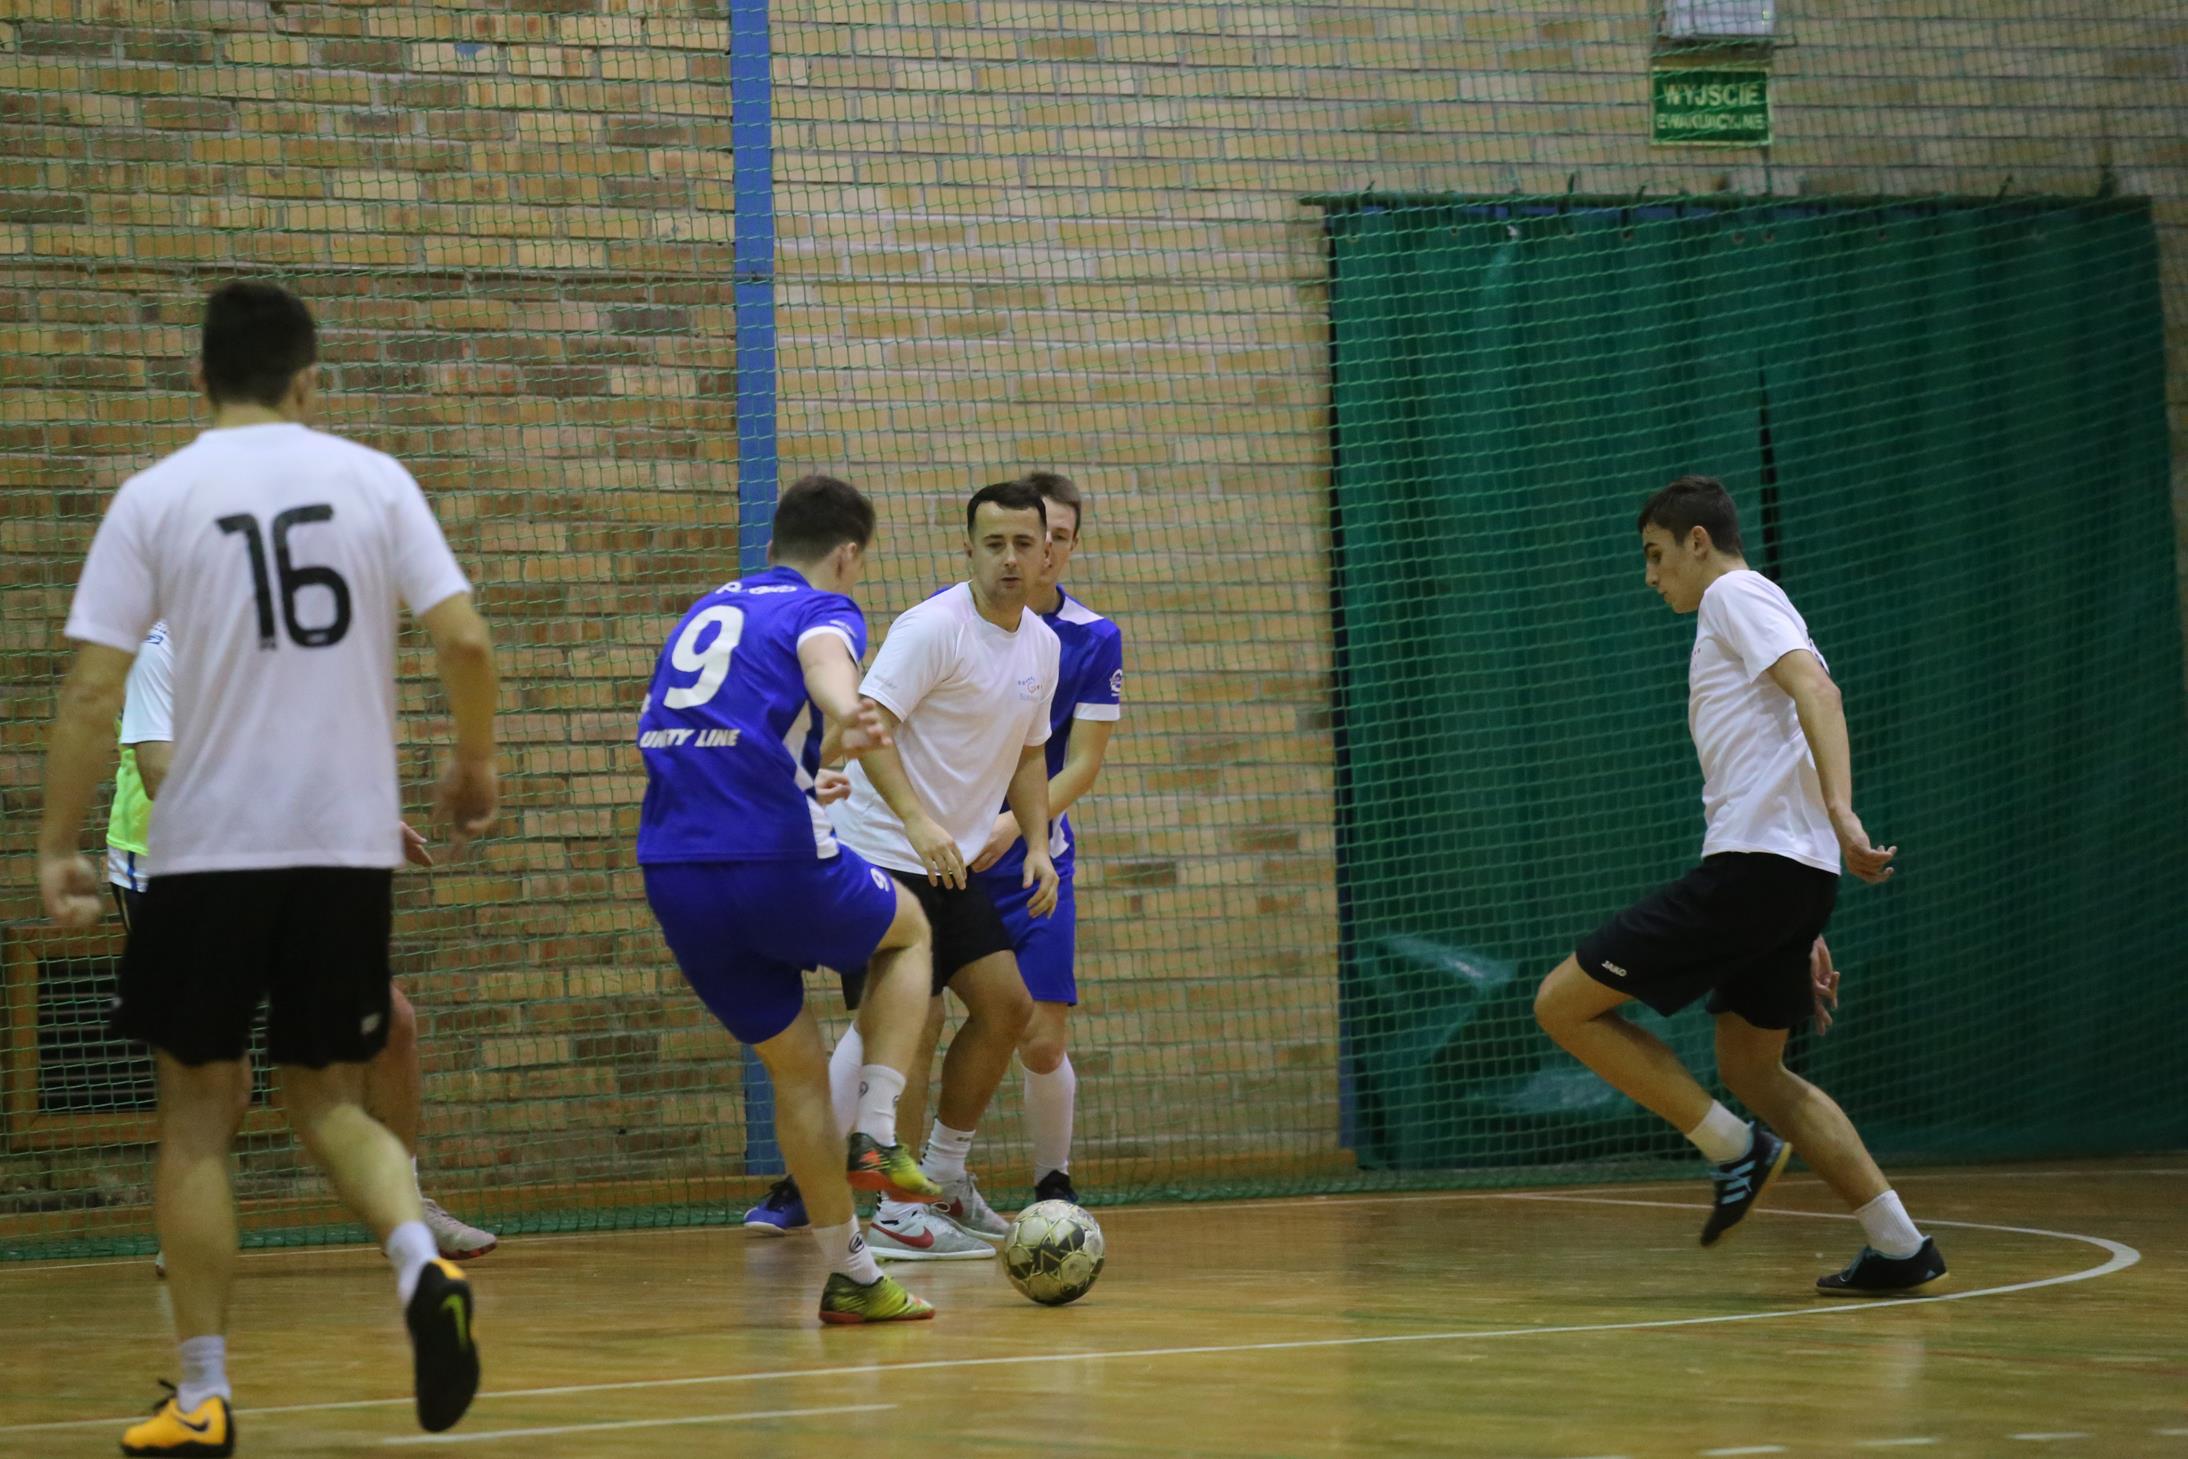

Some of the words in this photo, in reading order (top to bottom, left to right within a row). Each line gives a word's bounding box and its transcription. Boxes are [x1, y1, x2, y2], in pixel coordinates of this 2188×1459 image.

[215, 503, 351, 650] 16
[663, 605, 744, 710] 9
[694, 728, 741, 747] LINE
